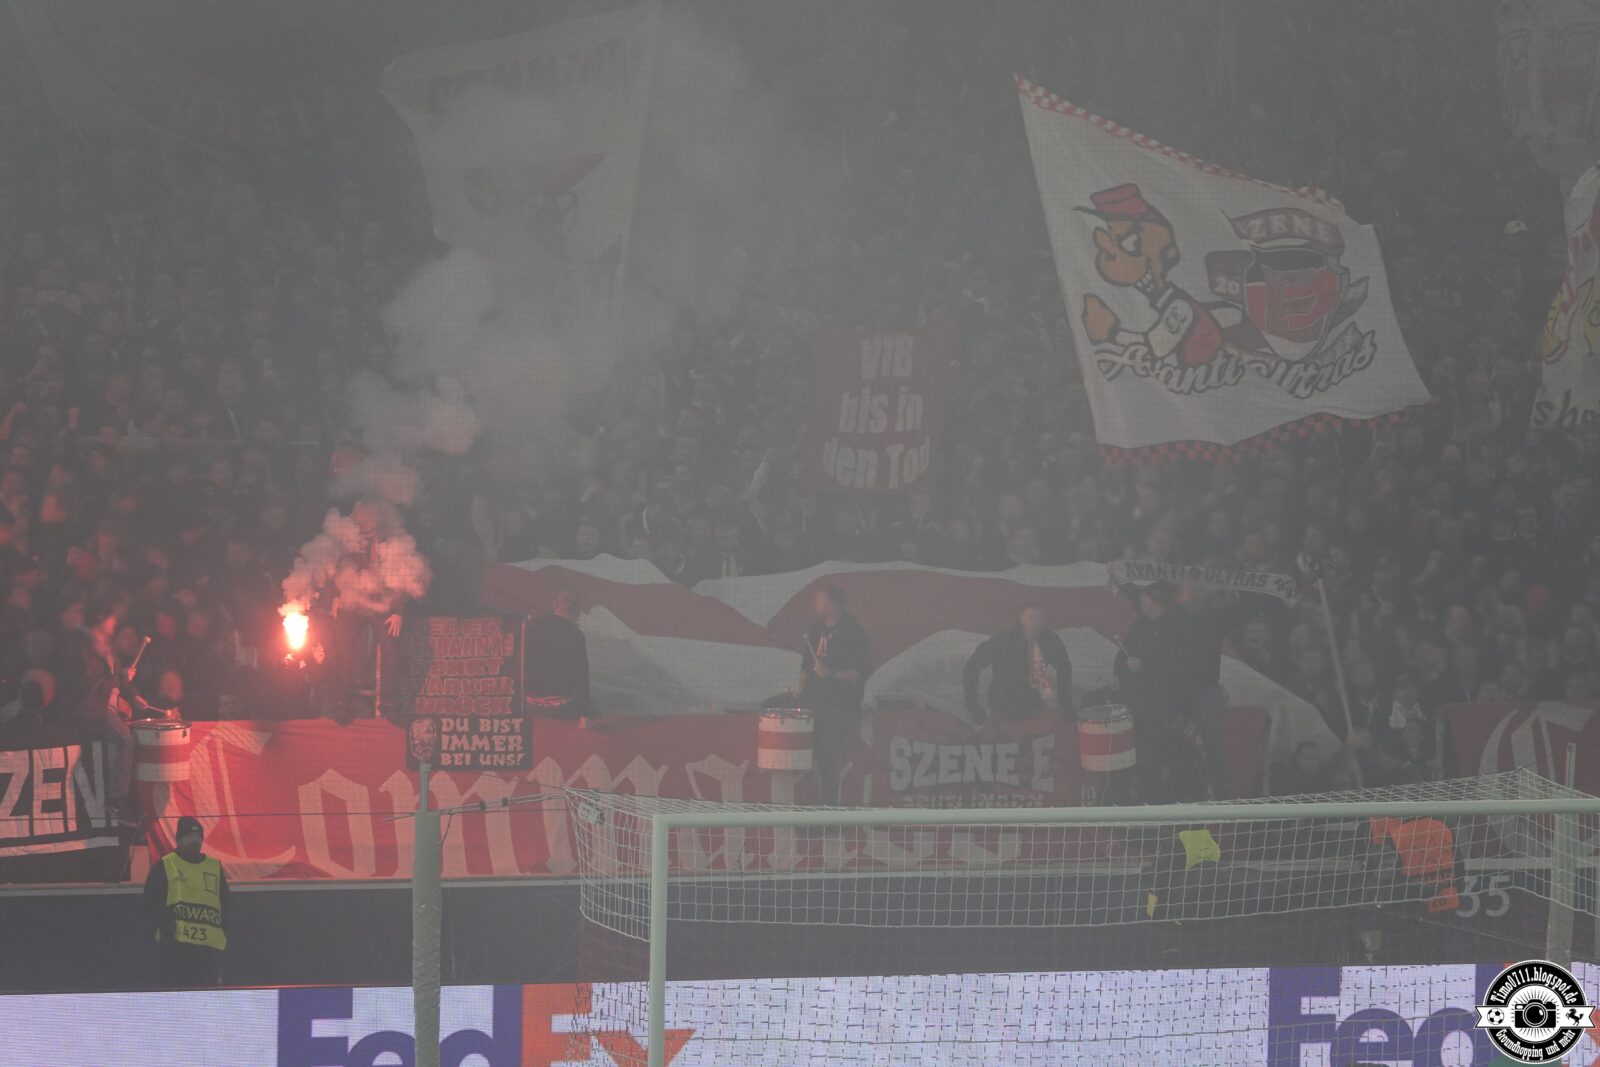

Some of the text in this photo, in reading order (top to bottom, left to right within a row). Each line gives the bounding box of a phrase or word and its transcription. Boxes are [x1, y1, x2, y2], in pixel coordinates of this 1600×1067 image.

[1093, 341, 1246, 396] Avanti
[838, 385, 924, 434] bis in
[822, 434, 931, 490] den Tod
[441, 718, 524, 733] DU BIST
[441, 734, 524, 751] IMMER
[441, 753, 526, 766] BEI UNS!
[888, 734, 1020, 792] SZENE
[1456, 875, 1510, 918] 35
[183, 926, 208, 941] 423
